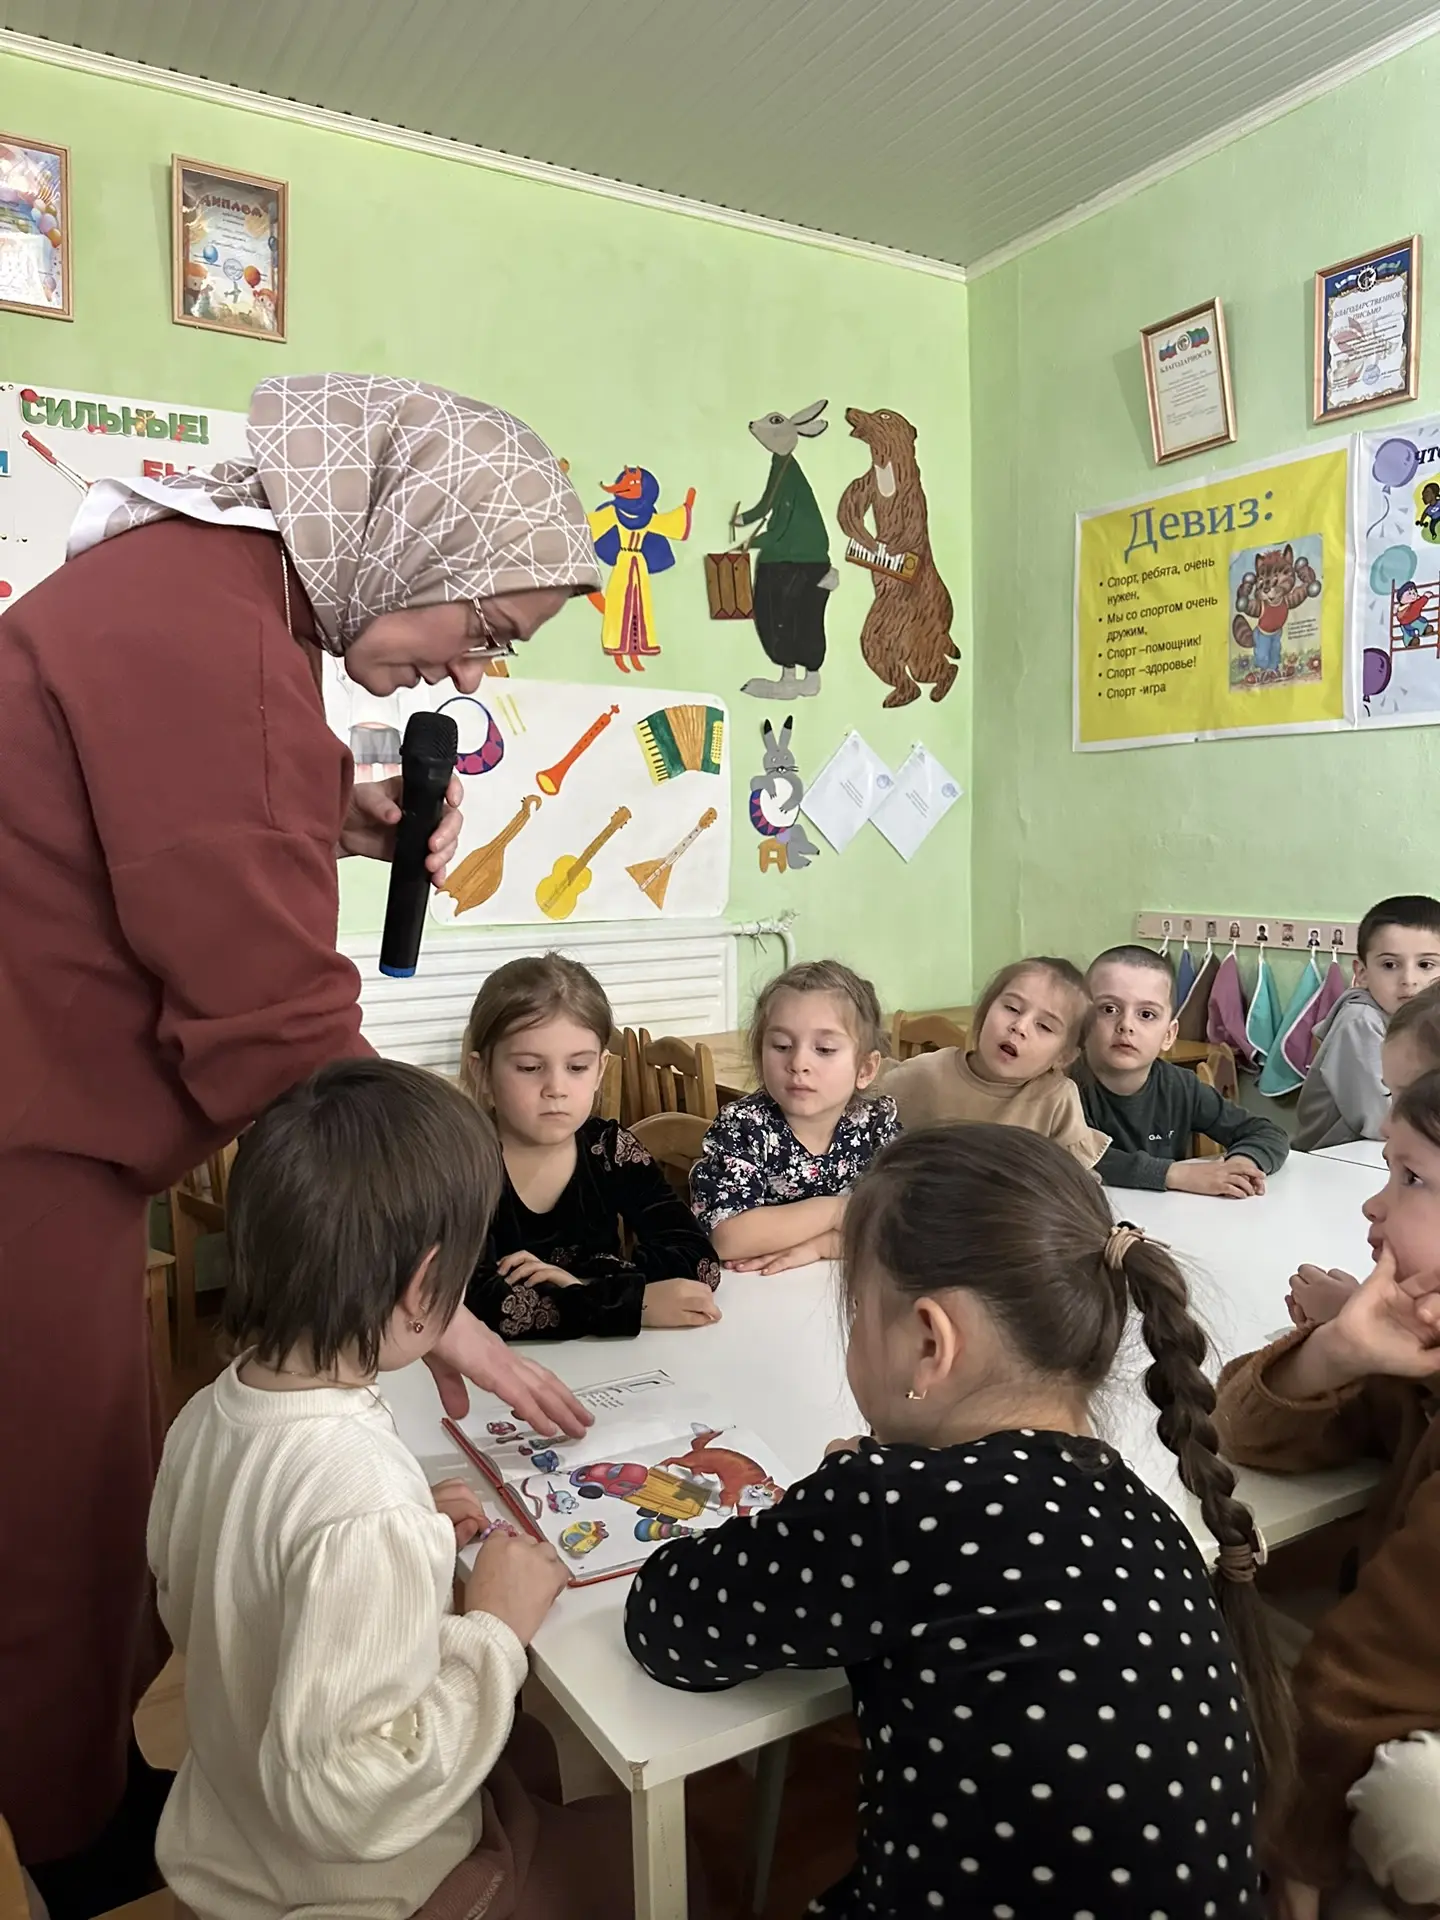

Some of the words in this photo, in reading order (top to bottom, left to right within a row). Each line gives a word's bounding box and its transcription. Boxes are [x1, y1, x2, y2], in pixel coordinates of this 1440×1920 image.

[20, 388, 209, 445] СИЛЬНЫЕ!
[1414, 446, 1440, 465] ЧТ
[1124, 490, 1273, 564] Девиз:
[1107, 573, 1140, 588] Спорт,
[1141, 565, 1181, 584] ребята,
[1183, 558, 1215, 572] очень
[1107, 613, 1124, 624] Мы
[1126, 610, 1138, 621] со
[1140, 602, 1183, 618] спортом
[1185, 596, 1218, 610] очень
[1106, 647, 1137, 660] Спорт
[1106, 666, 1137, 680] Спорт
[1106, 687, 1137, 700] Спорт
